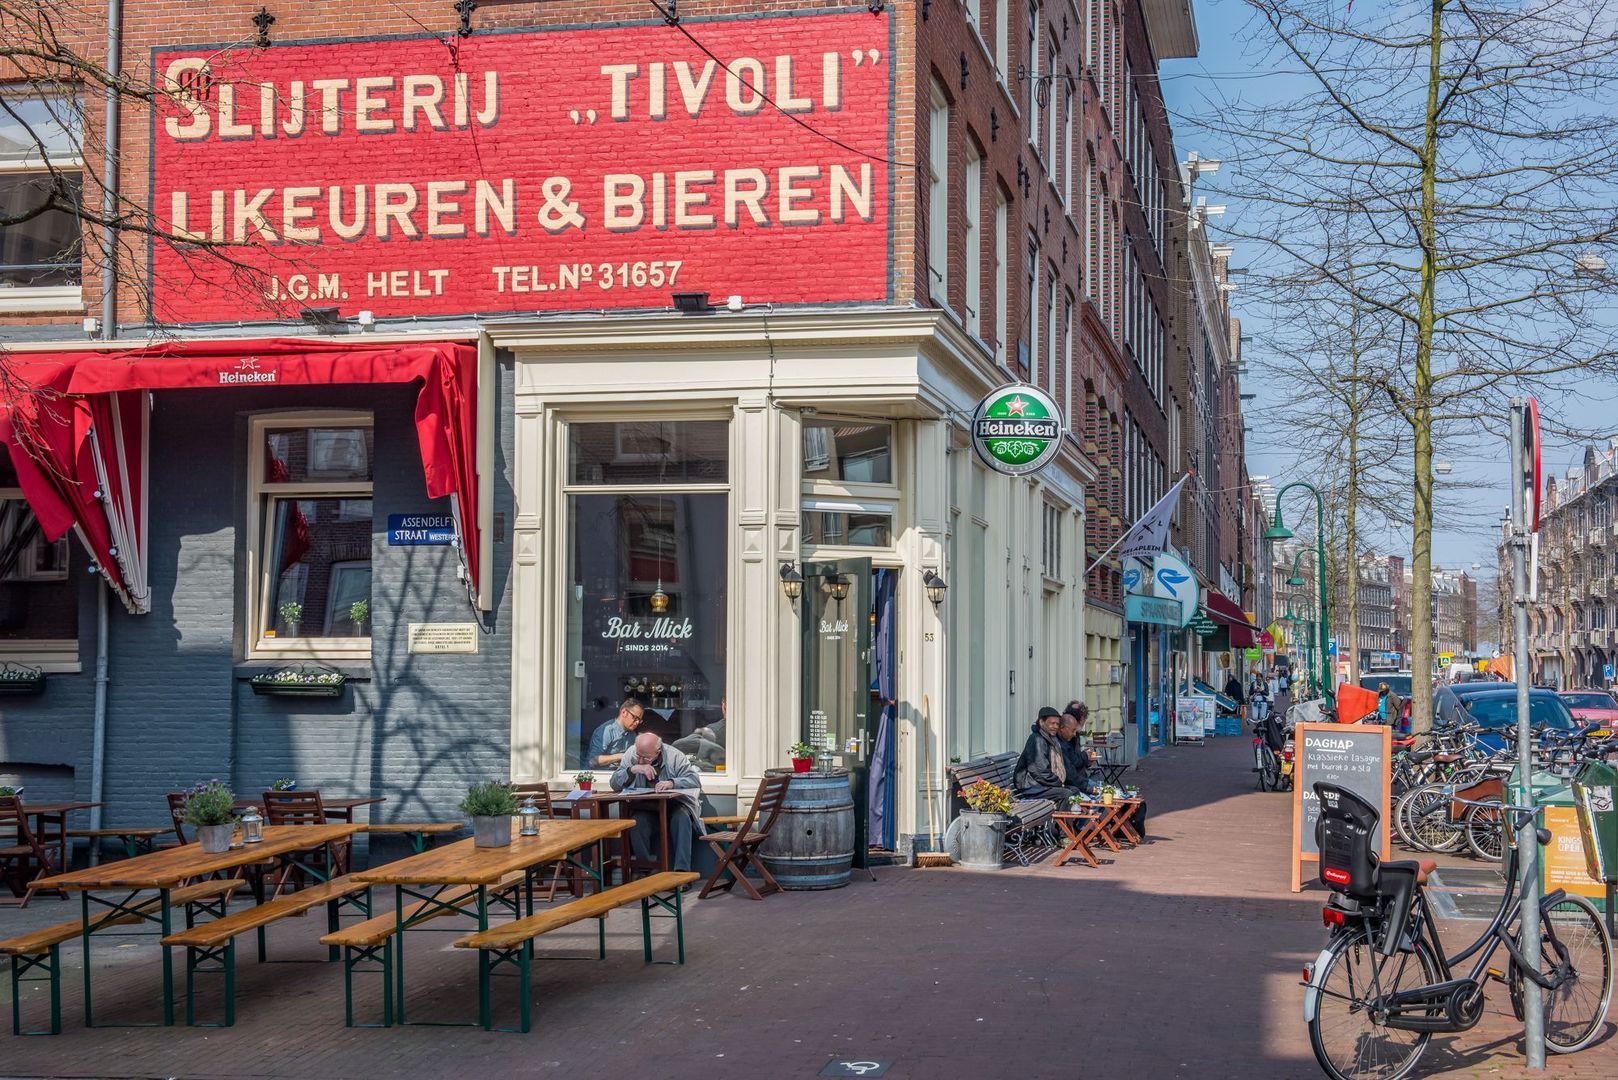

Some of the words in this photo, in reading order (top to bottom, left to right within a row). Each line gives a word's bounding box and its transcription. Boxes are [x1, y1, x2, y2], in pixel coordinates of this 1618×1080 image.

[164, 57, 500, 141] SLIJTERIJ
[171, 179, 518, 243] LIKEUREN
[537, 176, 587, 232] &
[603, 162, 874, 231] BIEREN
[267, 273, 349, 300] J.G.M.
[367, 269, 450, 298] HELT
[597, 260, 683, 290] 31657
[219, 371, 276, 384] Heineken
[979, 421, 1056, 436] Heineken
[394, 530, 428, 540] STRAAT
[602, 617, 641, 638] Bar
[644, 617, 692, 638] Mick
[924, 633, 934, 642] 53
[1304, 737, 1354, 750] DAGHAP
